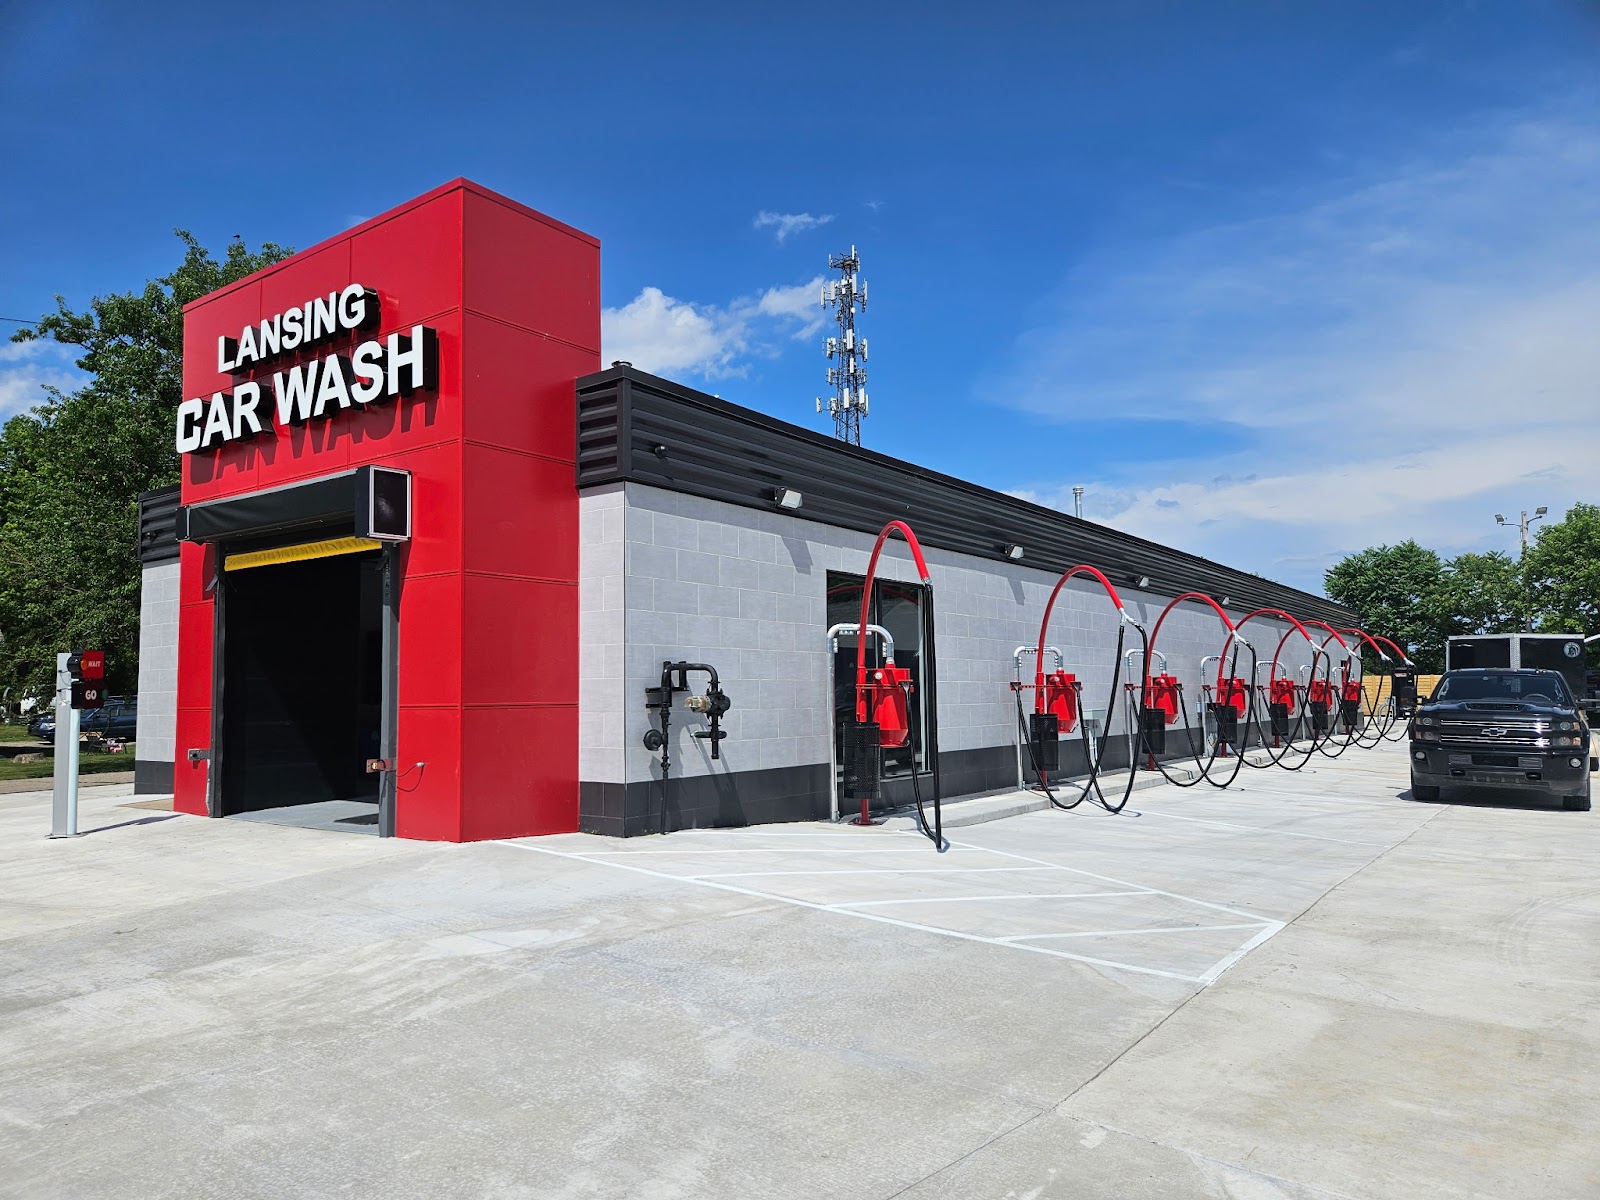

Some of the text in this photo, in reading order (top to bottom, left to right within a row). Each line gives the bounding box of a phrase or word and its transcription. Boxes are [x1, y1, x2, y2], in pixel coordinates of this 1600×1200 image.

[218, 283, 366, 373] LANSING
[176, 324, 424, 454] CAR WASH
[85, 690, 97, 700] GO
